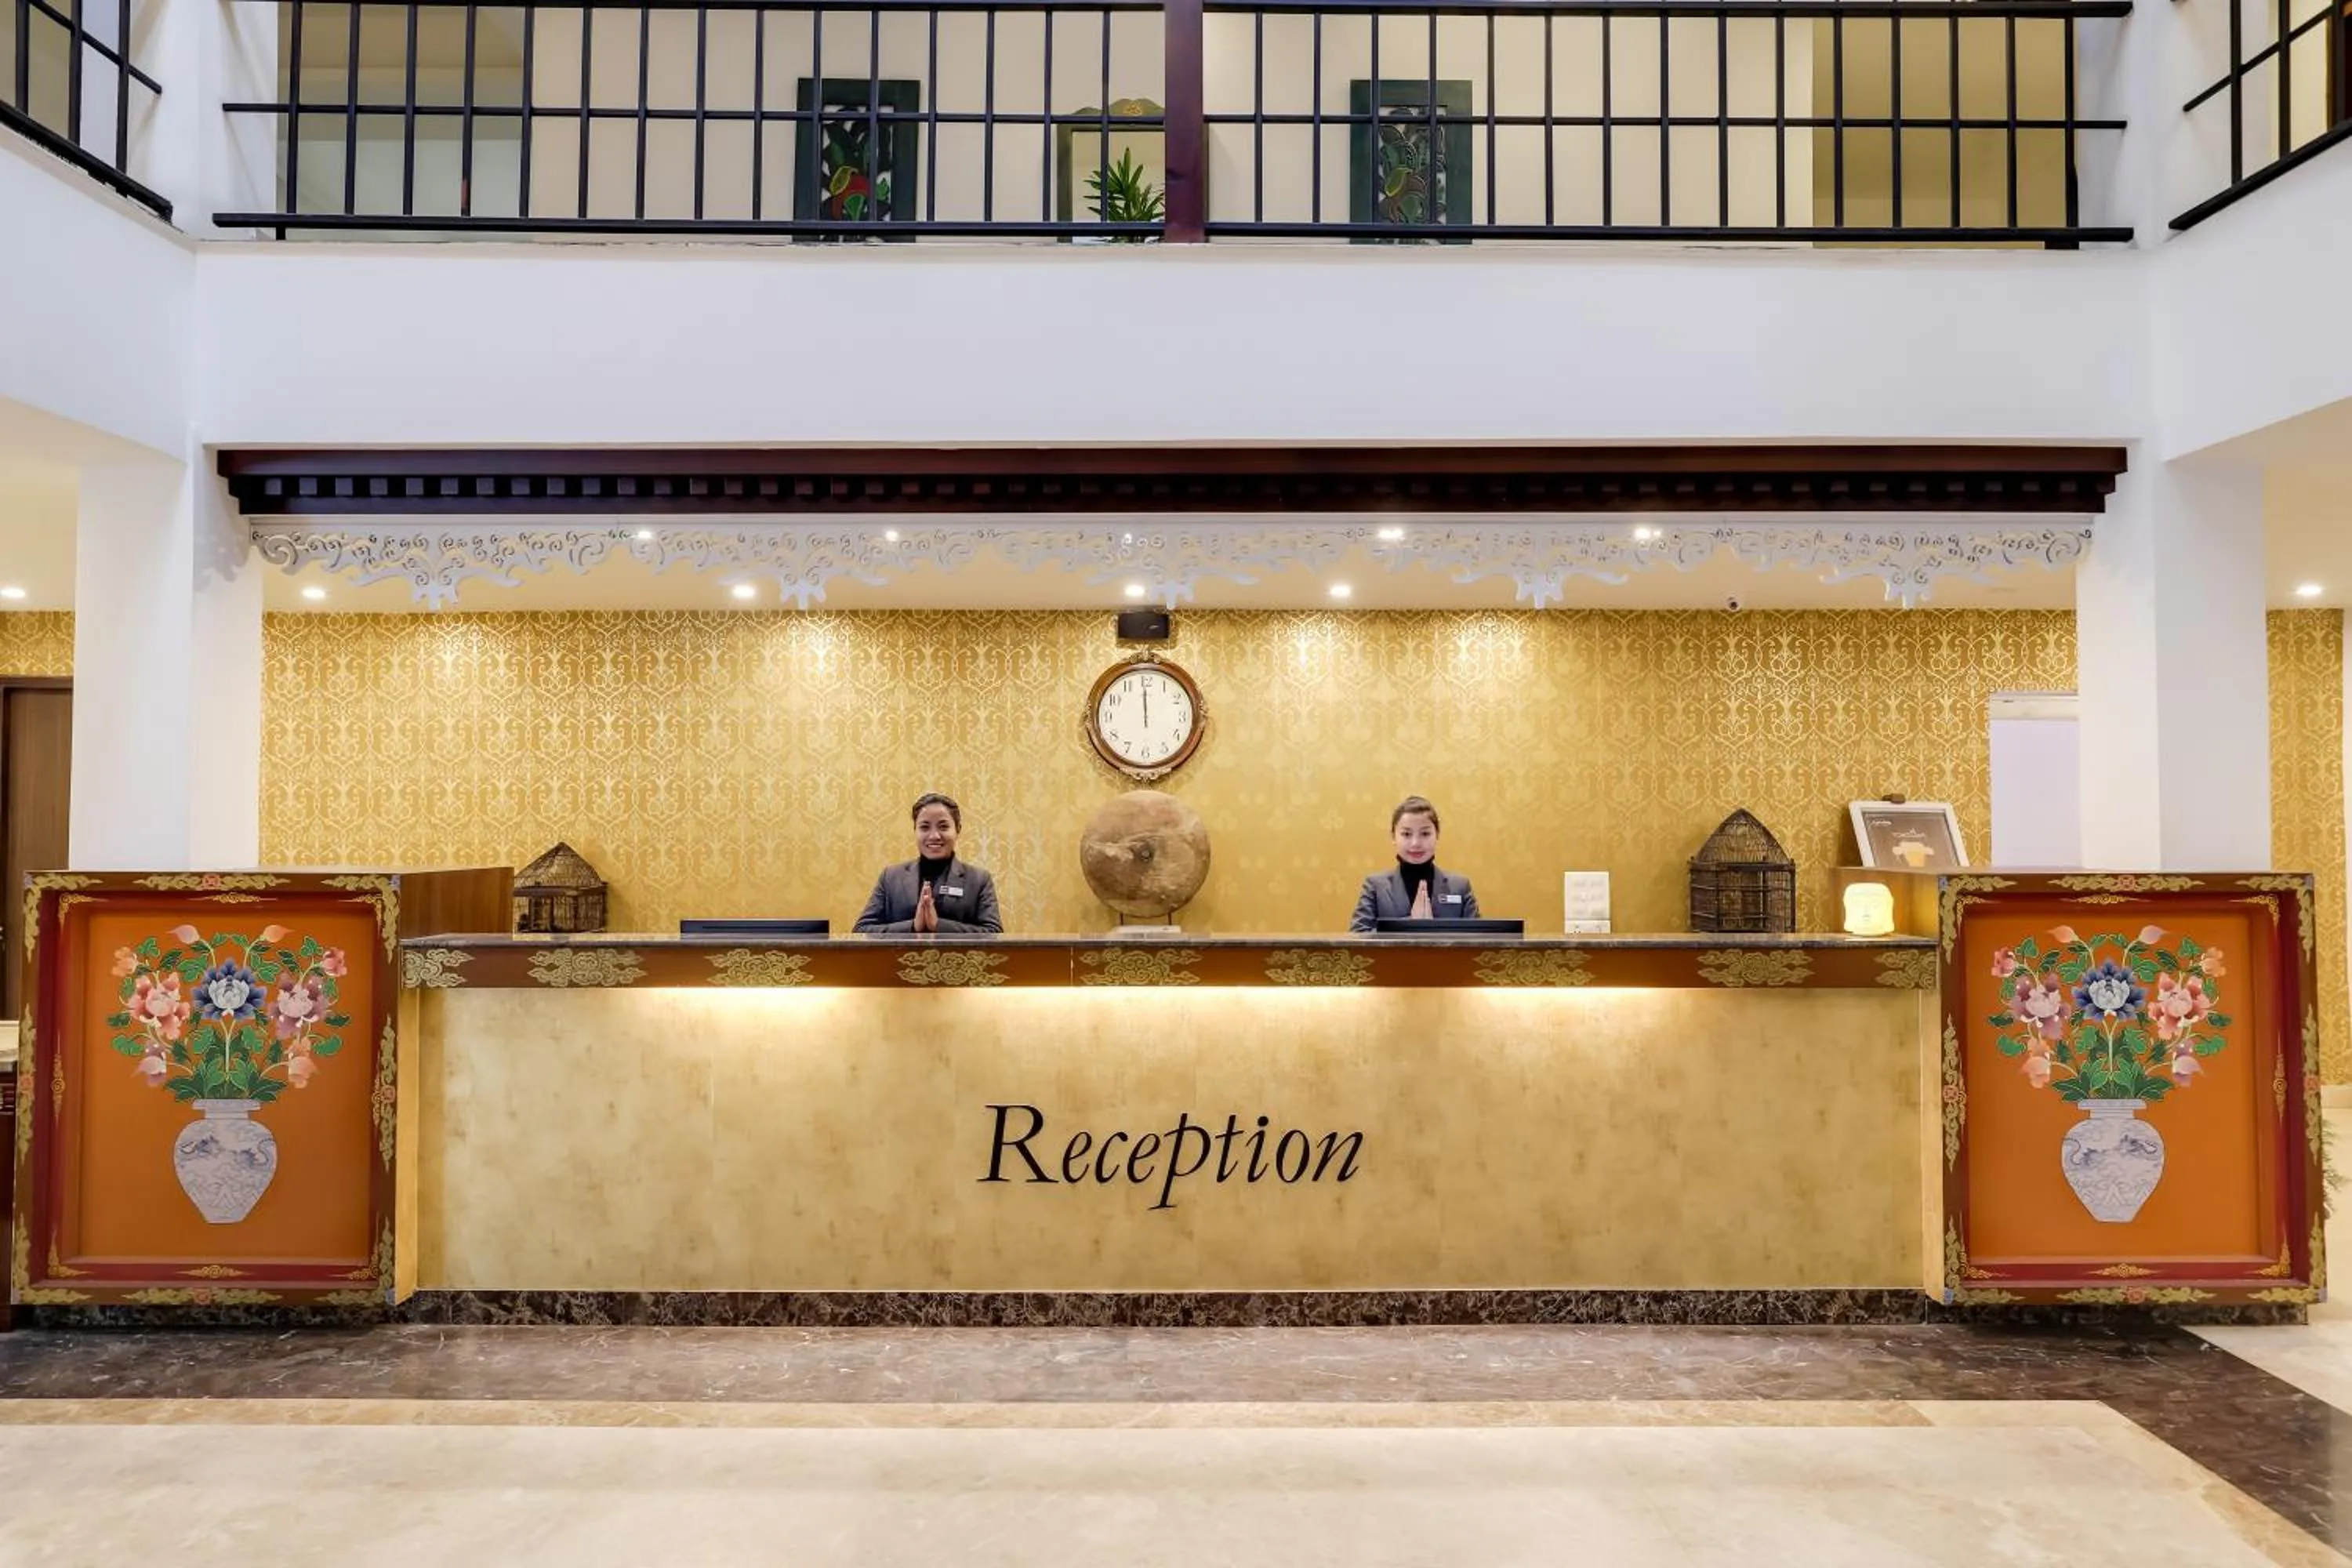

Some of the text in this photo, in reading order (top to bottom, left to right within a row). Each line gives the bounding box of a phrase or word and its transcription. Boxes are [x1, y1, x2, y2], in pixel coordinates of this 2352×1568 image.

[1123, 681, 1132, 692] 11
[1142, 676, 1153, 688] 12
[1109, 694, 1122, 706] 10
[1172, 693, 1181, 705] 2
[1105, 711, 1112, 723] 9
[1178, 711, 1186, 723] 3
[1109, 731, 1119, 741] 8
[1172, 729, 1180, 741] 4
[1123, 742, 1131, 753] 7
[1141, 747, 1150, 759] 6
[1160, 742, 1169, 753] 5
[977, 1105, 1363, 1210] Reception
